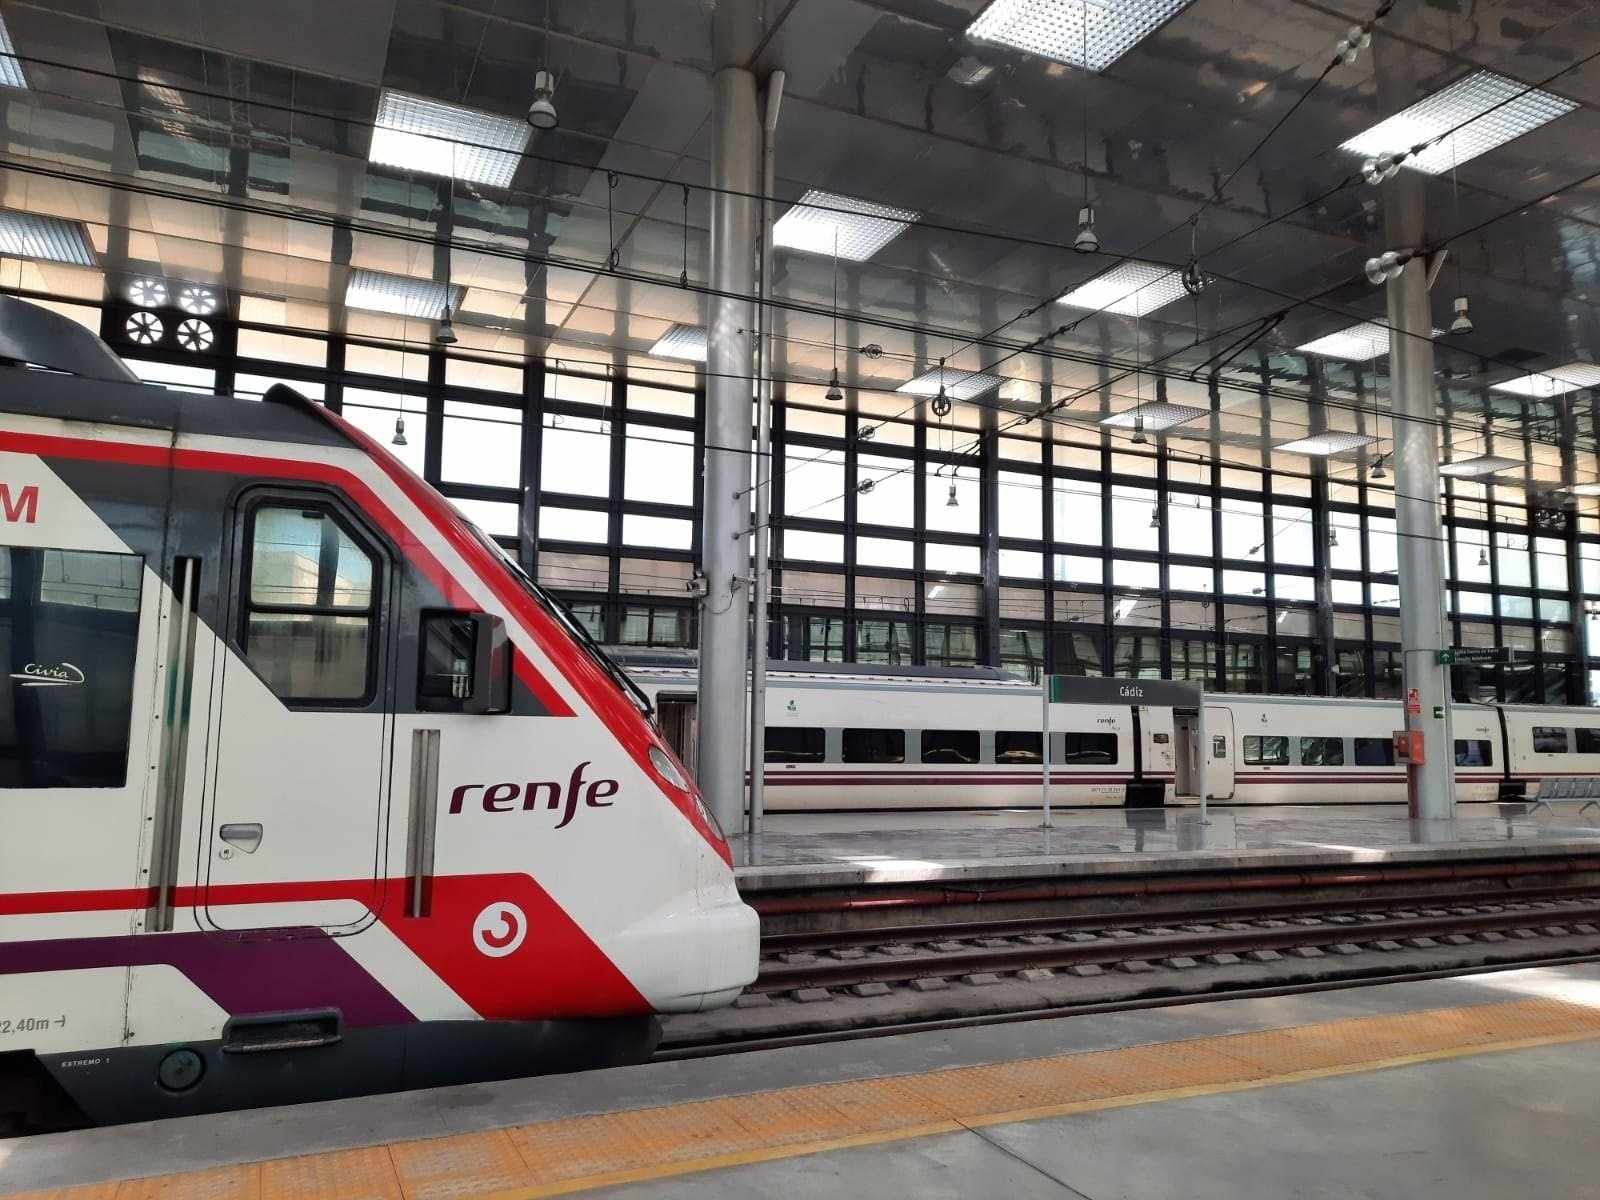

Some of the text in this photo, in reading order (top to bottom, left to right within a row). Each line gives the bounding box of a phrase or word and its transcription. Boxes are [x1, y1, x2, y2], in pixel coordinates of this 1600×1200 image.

[1119, 686, 1144, 697] Cádiz
[449, 761, 619, 829] renfe
[0, 1018, 49, 1034] 2,40m
